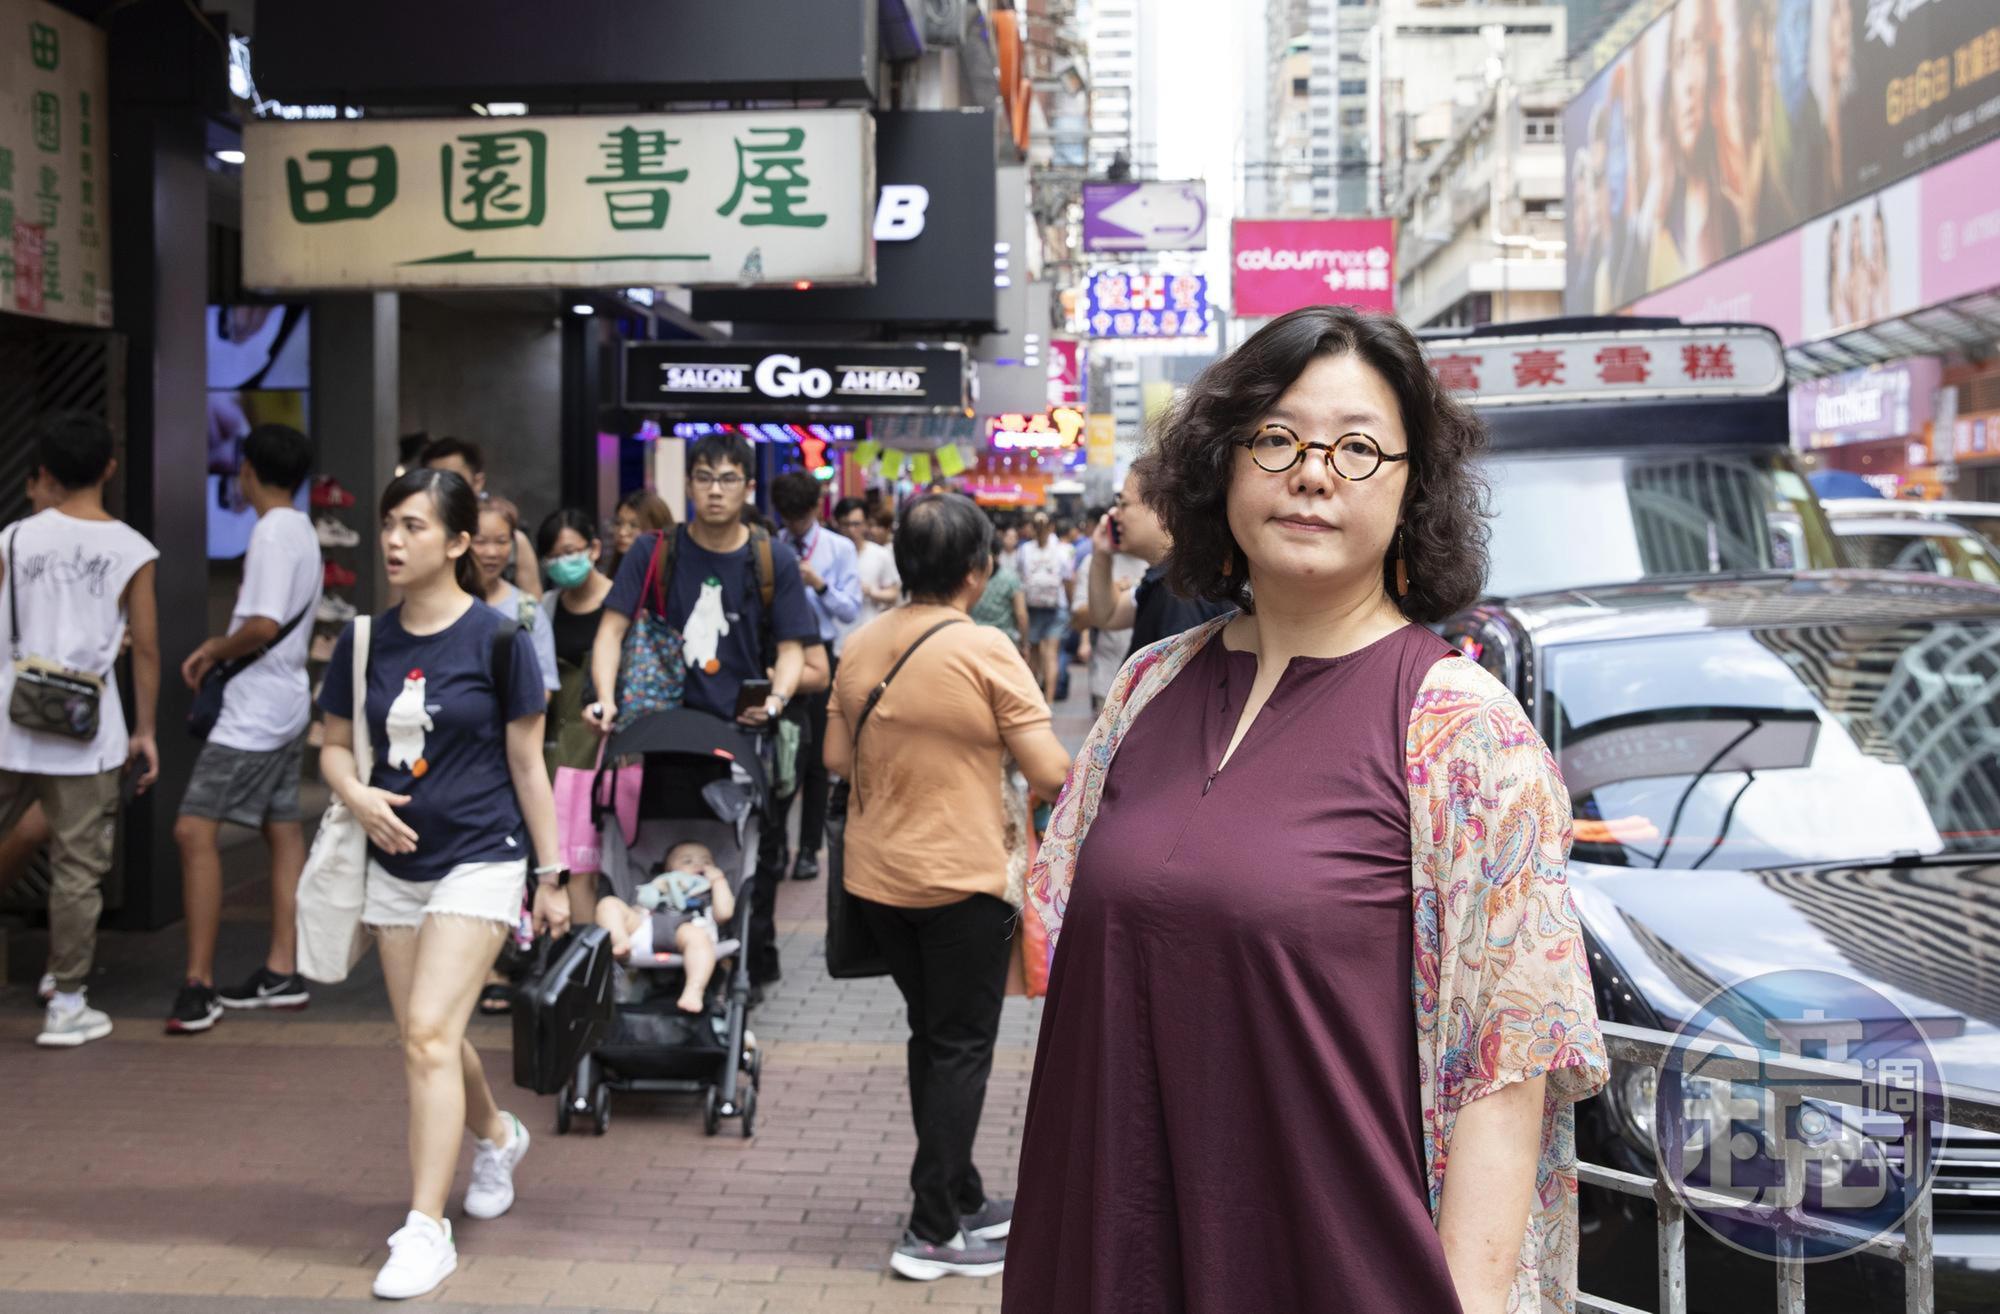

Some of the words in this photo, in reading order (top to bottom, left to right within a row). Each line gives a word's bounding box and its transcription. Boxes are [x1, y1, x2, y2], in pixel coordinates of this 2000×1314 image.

[1886, 56, 1949, 126] 6月6日
[286, 125, 827, 231] 田園書屋
[667, 366, 744, 389] SALON
[754, 353, 833, 398] Go
[841, 370, 921, 391] AHEAD
[1427, 342, 1735, 390] 富豪雪糕
